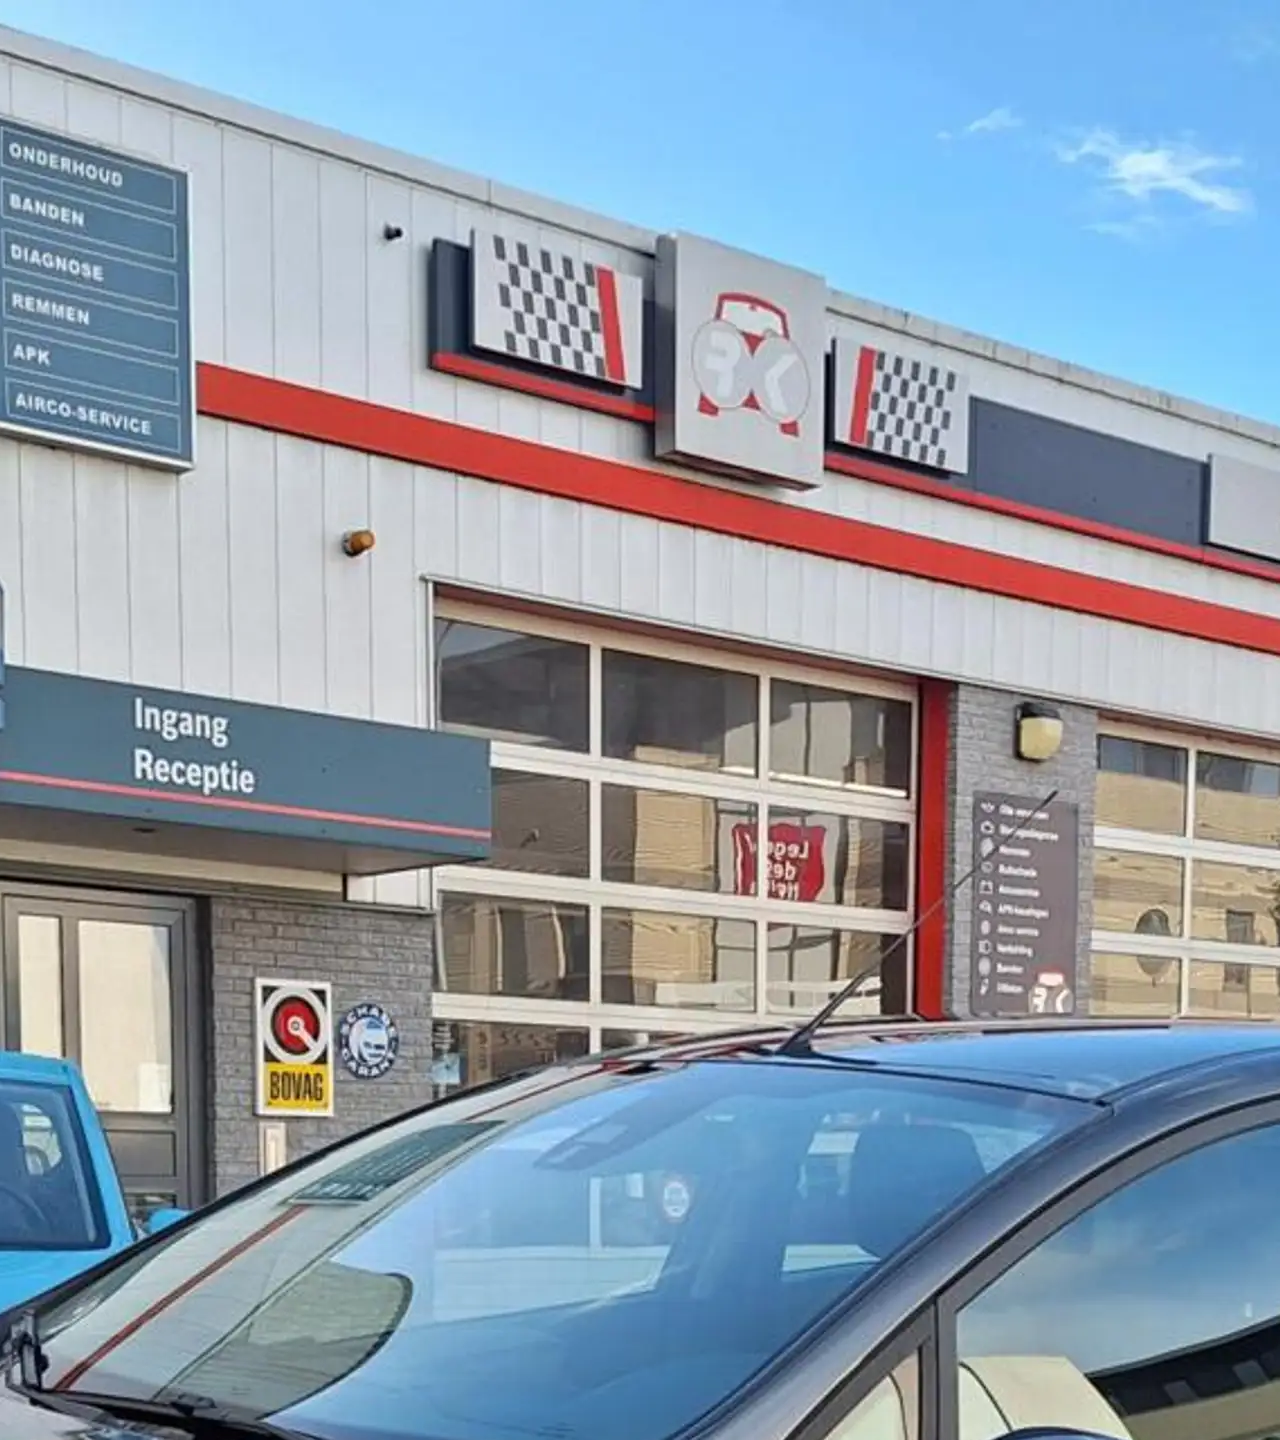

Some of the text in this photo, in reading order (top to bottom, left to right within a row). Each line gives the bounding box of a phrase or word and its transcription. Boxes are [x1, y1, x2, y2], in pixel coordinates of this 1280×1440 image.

[8, 141, 124, 188] ONDERHOUD
[9, 192, 86, 227] BANDEN
[10, 243, 105, 282] DIAGNOSE
[11, 292, 91, 326] REMMEN
[12, 343, 52, 366] APK
[14, 391, 153, 436] AIRCO-SERVICE
[134, 697, 230, 748] Ingang
[134, 748, 256, 796] Receptie
[269, 1070, 324, 1101] BOVAG
